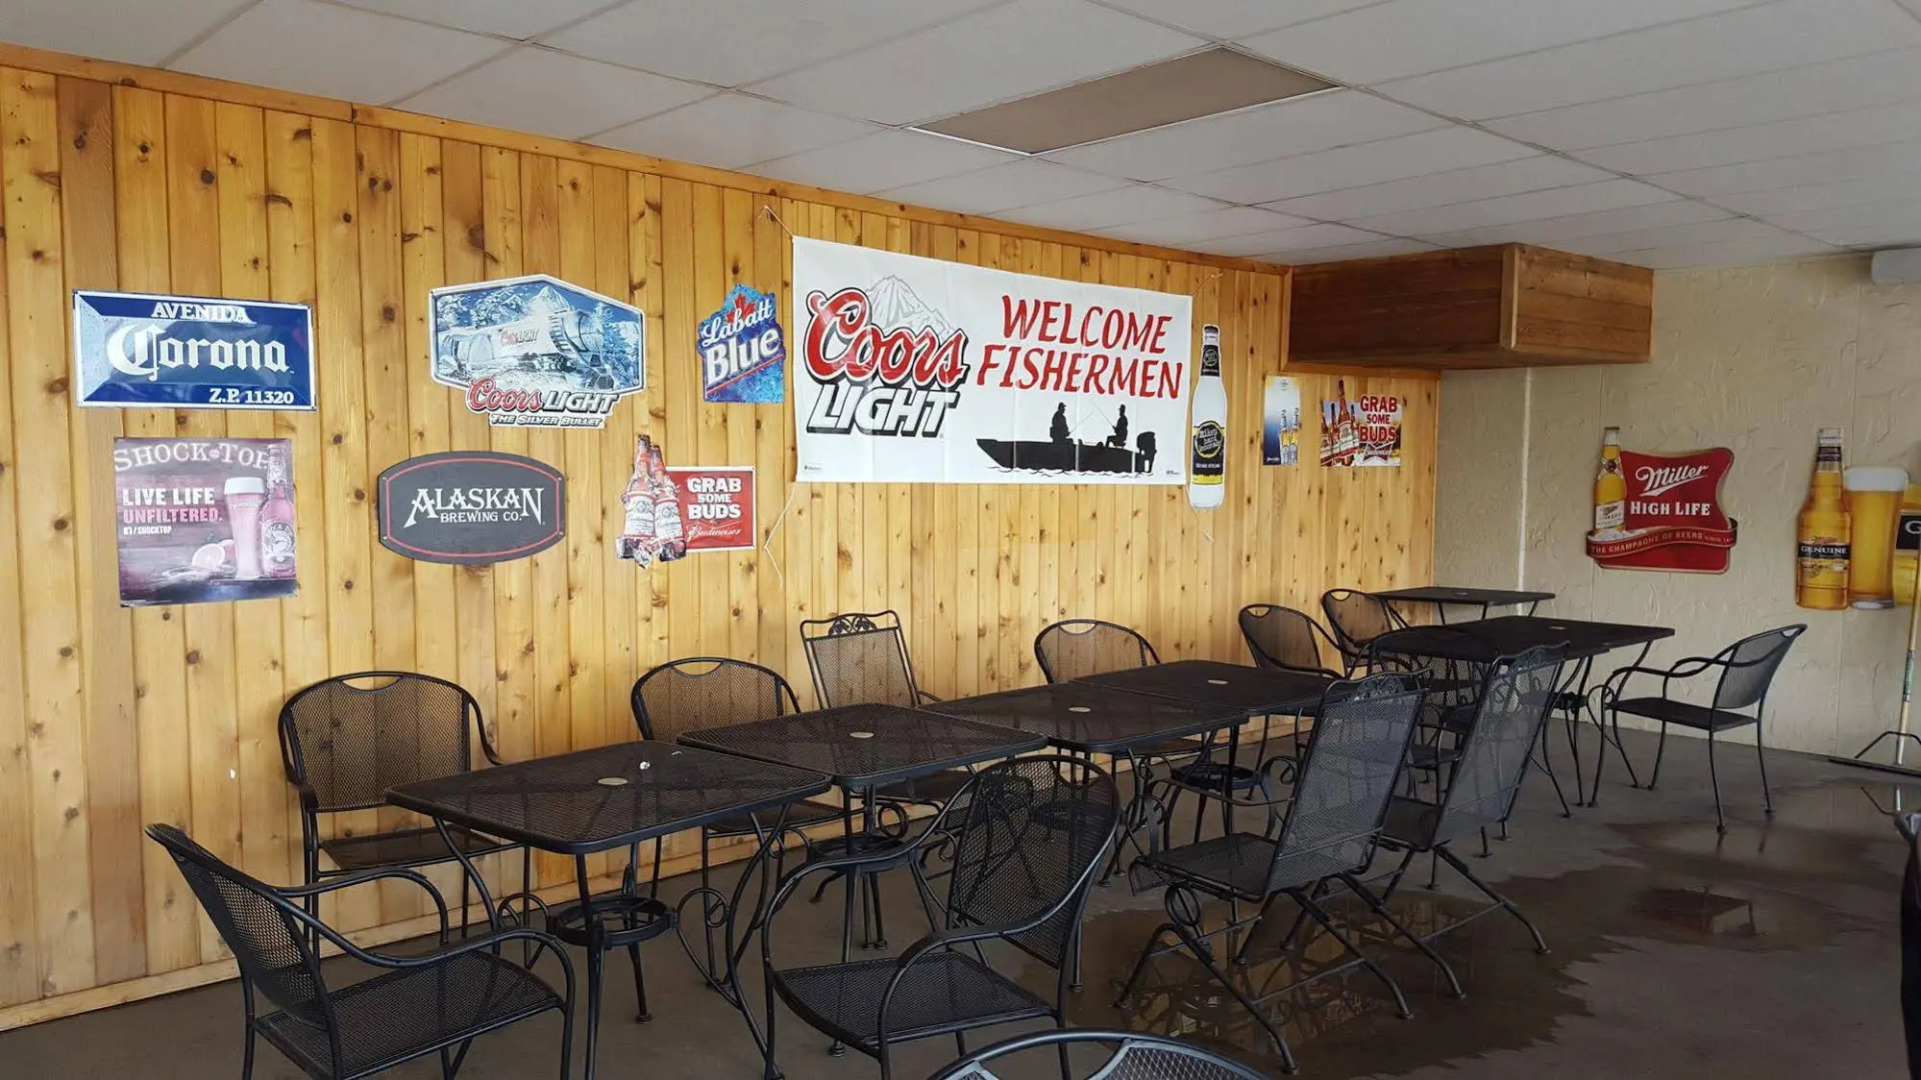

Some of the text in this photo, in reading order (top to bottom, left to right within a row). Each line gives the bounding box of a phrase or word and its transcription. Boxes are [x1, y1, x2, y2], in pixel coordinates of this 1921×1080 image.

[151, 302, 255, 324] AVENIDA
[702, 299, 772, 347] Labatt
[1001, 295, 1173, 354] WELCOME
[804, 287, 970, 388] Coors
[107, 323, 290, 381] Corona
[706, 328, 781, 386] Blue
[976, 343, 1183, 399] FISHERMEN
[209, 388, 295, 404] Z.P. 11320
[467, 378, 619, 413] Coors LIGHT
[1360, 395, 1398, 413] GRAB
[806, 384, 960, 437] LIGHT
[1366, 414, 1390, 424] SOME
[490, 414, 603, 427] THE SILVER BULLET
[1359, 425, 1397, 443] BUDS
[114, 443, 271, 472] SHOCK TOP
[687, 478, 742, 493] GRAB
[1635, 464, 1709, 496] Miller
[122, 487, 215, 506] LIVE LIFE
[697, 494, 732, 503] SOME
[123, 508, 223, 524] UNFILTERED.
[403, 488, 545, 528] ALASKAN
[440, 511, 523, 523] BREWING CO.
[688, 504, 742, 519] BUDS
[1630, 501, 1711, 516] HIGH LIFE
[687, 522, 742, 542] Budweiser
[1662, 532, 1672, 540] OF
[1675, 531, 1703, 540] BEERS
[1800, 545, 1848, 555] GENUINE
